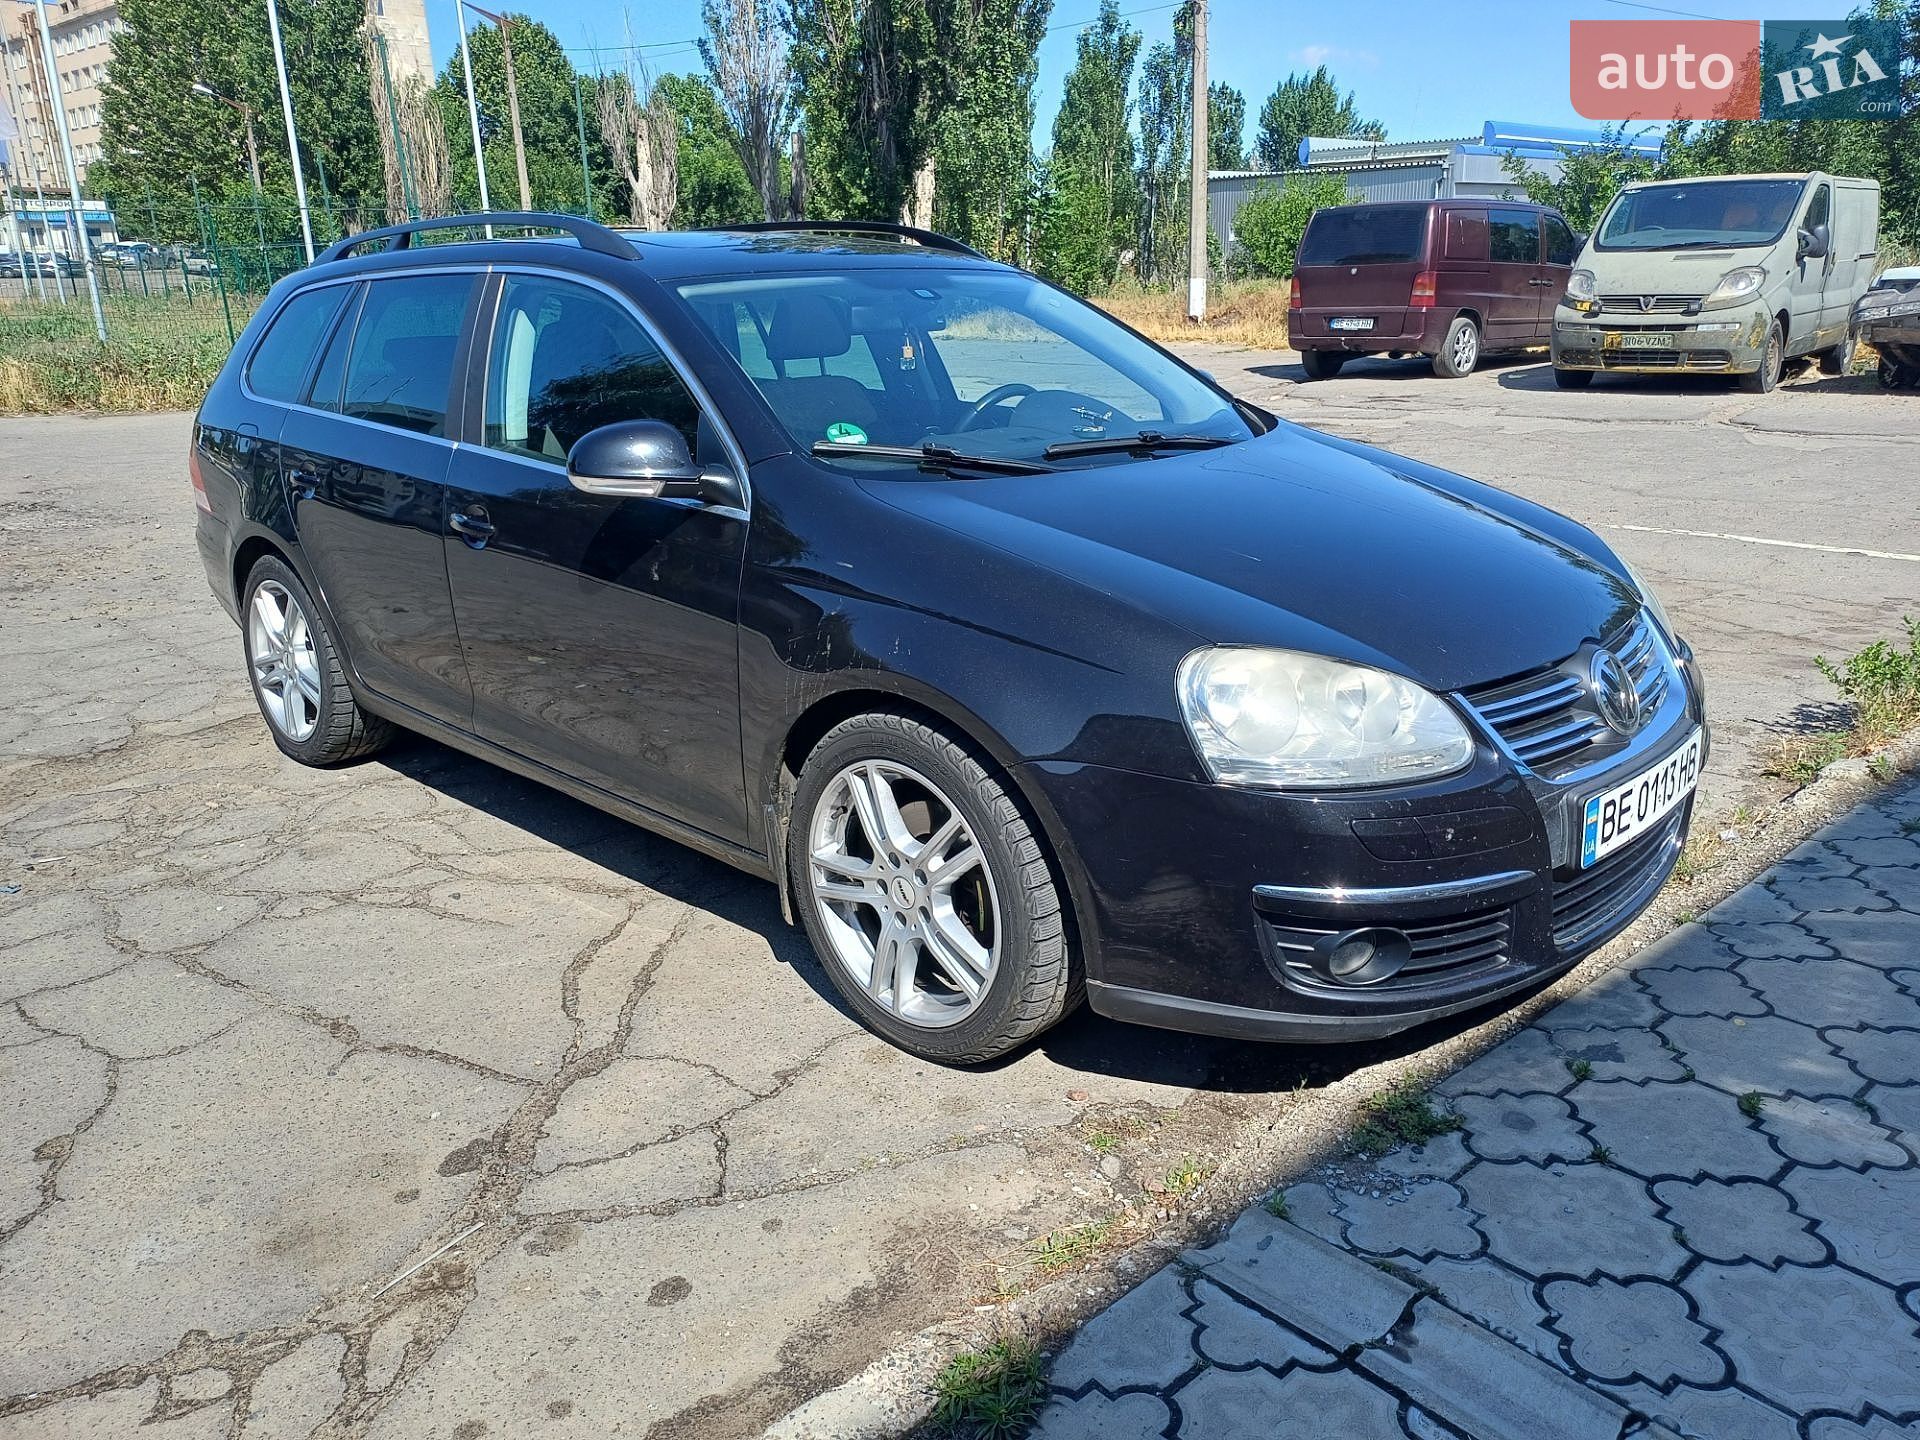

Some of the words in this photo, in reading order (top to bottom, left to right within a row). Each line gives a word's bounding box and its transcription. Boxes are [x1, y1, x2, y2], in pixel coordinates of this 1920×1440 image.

[13, 200, 85, 208] АТОБРОКР
[838, 423, 851, 436] 4
[1601, 789, 1633, 845] BE
[1637, 758, 1678, 822] 0113
[1678, 742, 1697, 792] HB
[1584, 838, 1596, 855] UA
